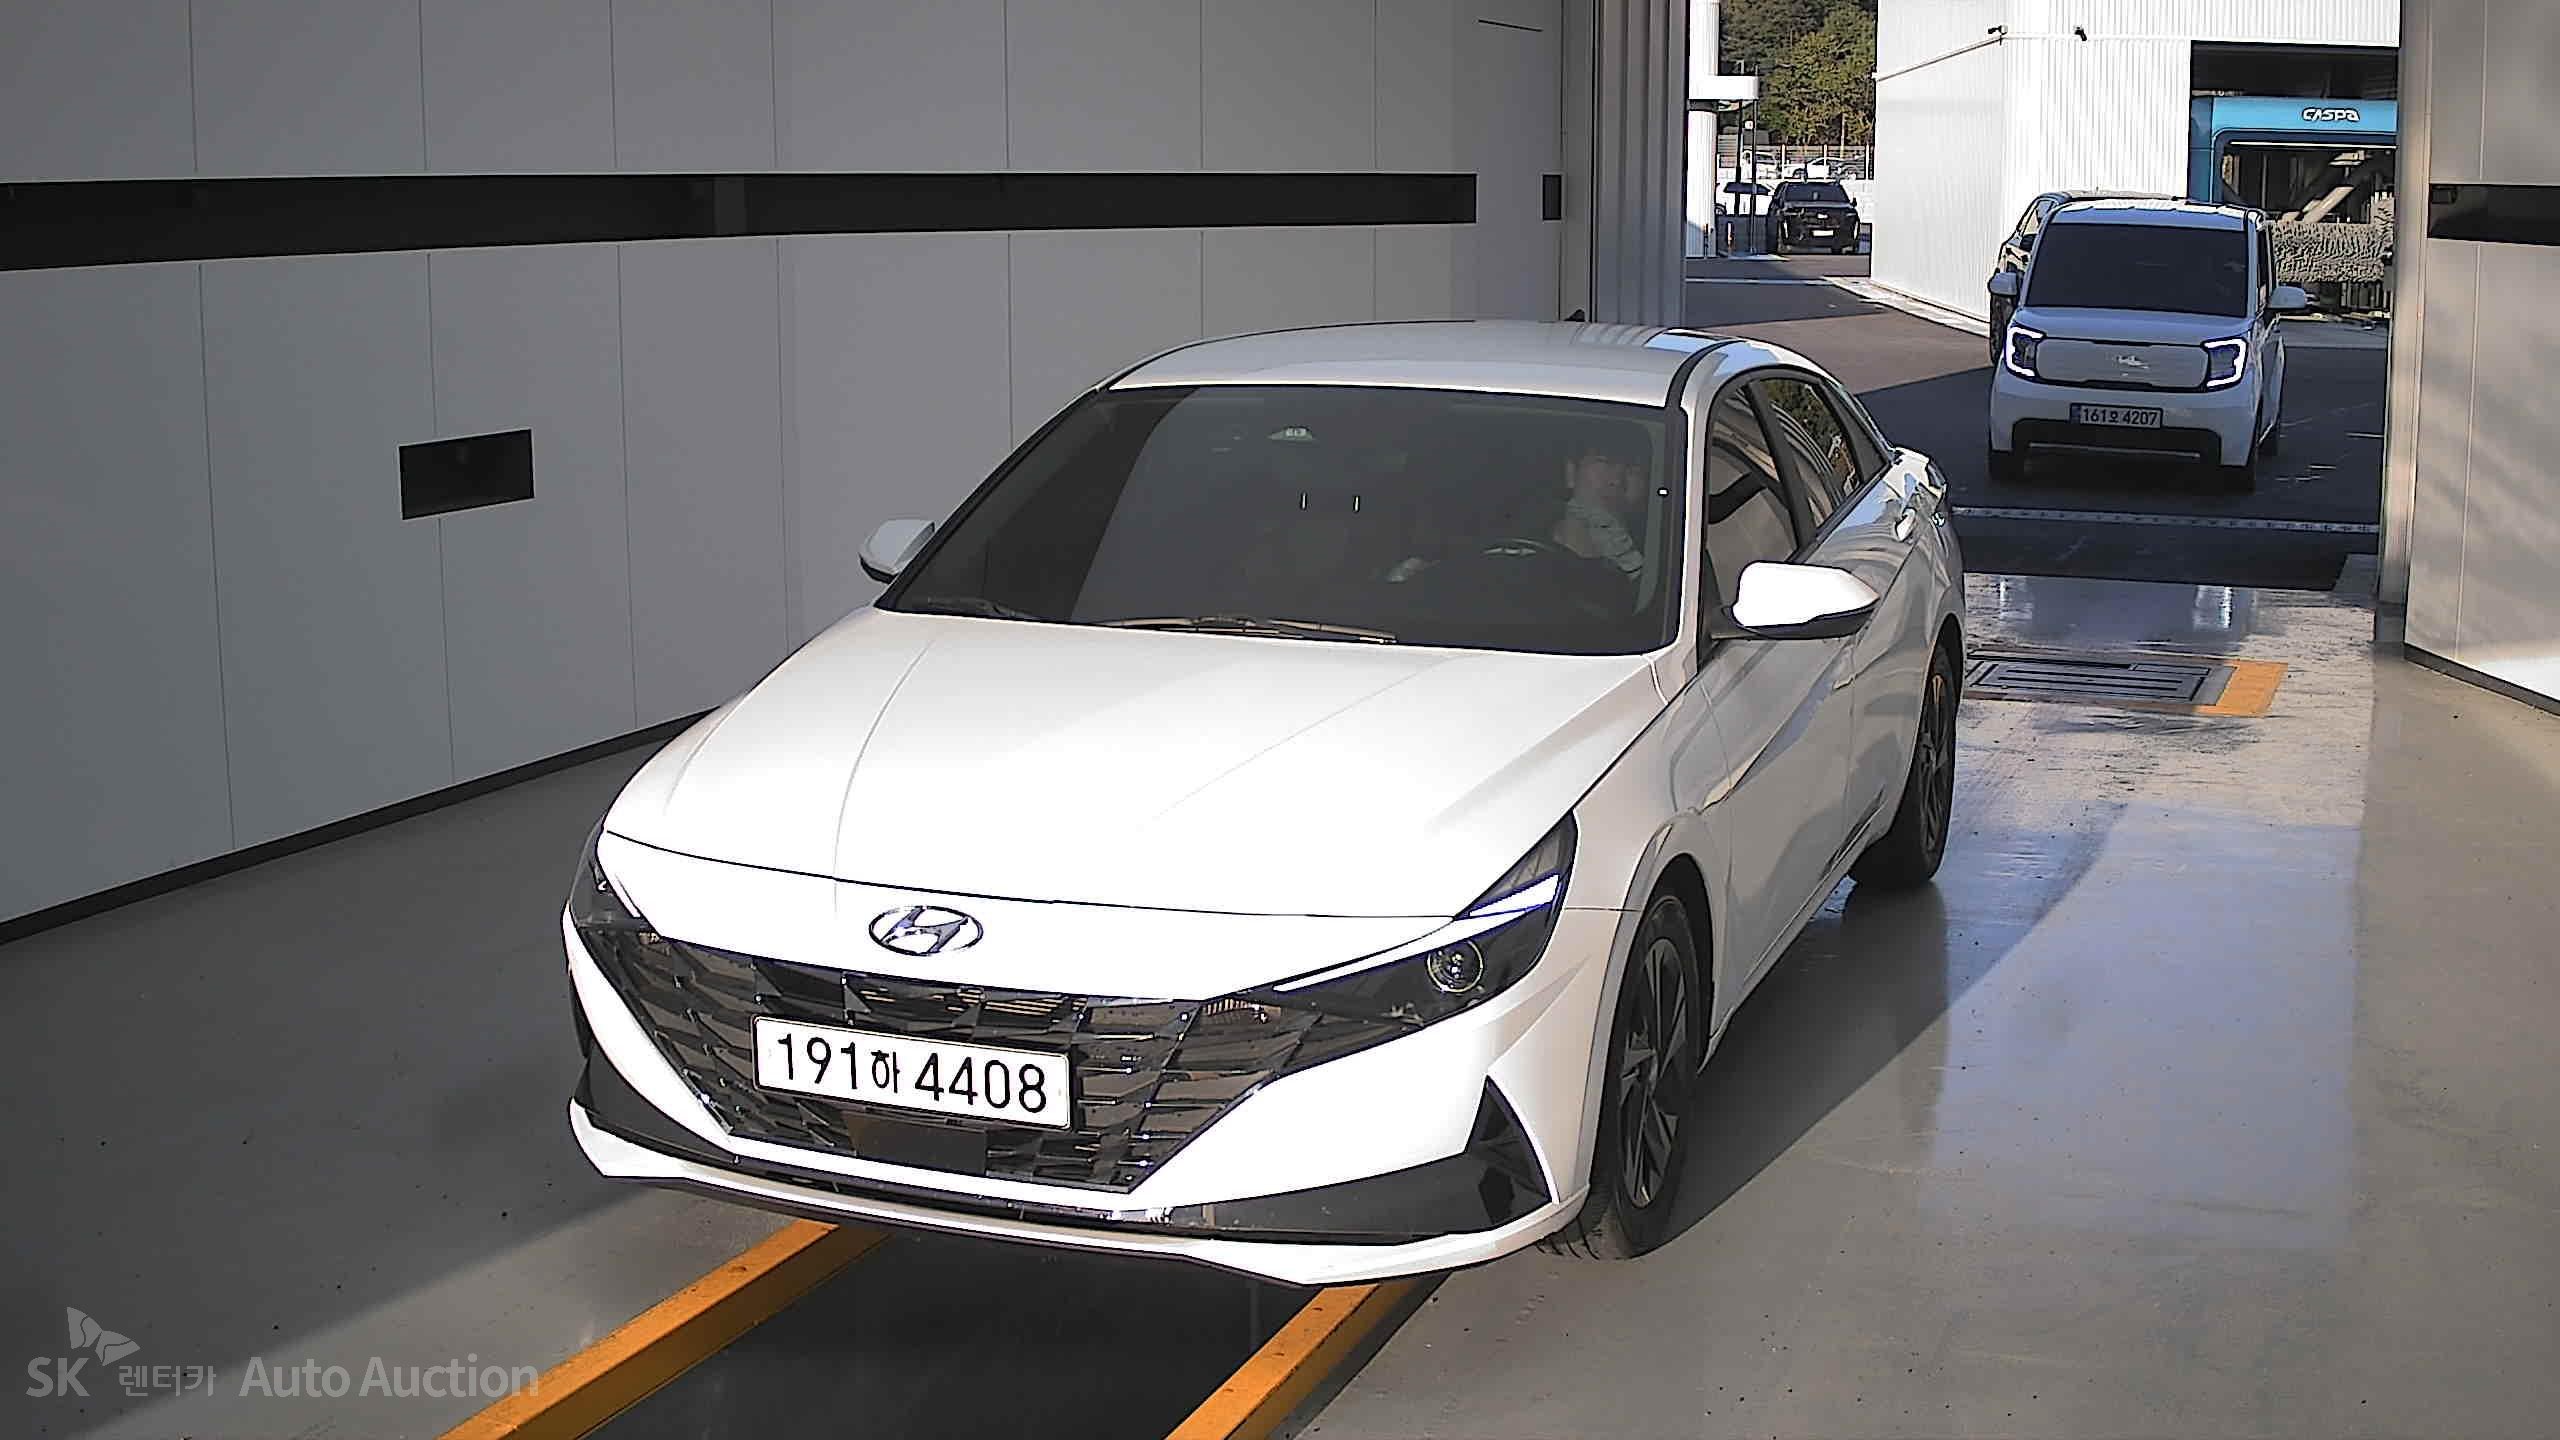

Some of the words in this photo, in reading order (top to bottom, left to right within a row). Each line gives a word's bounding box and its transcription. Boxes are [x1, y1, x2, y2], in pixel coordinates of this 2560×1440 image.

[2122, 411, 2157, 425] 4207
[778, 1033, 900, 1093] 191하
[915, 1053, 1046, 1113] 4408
